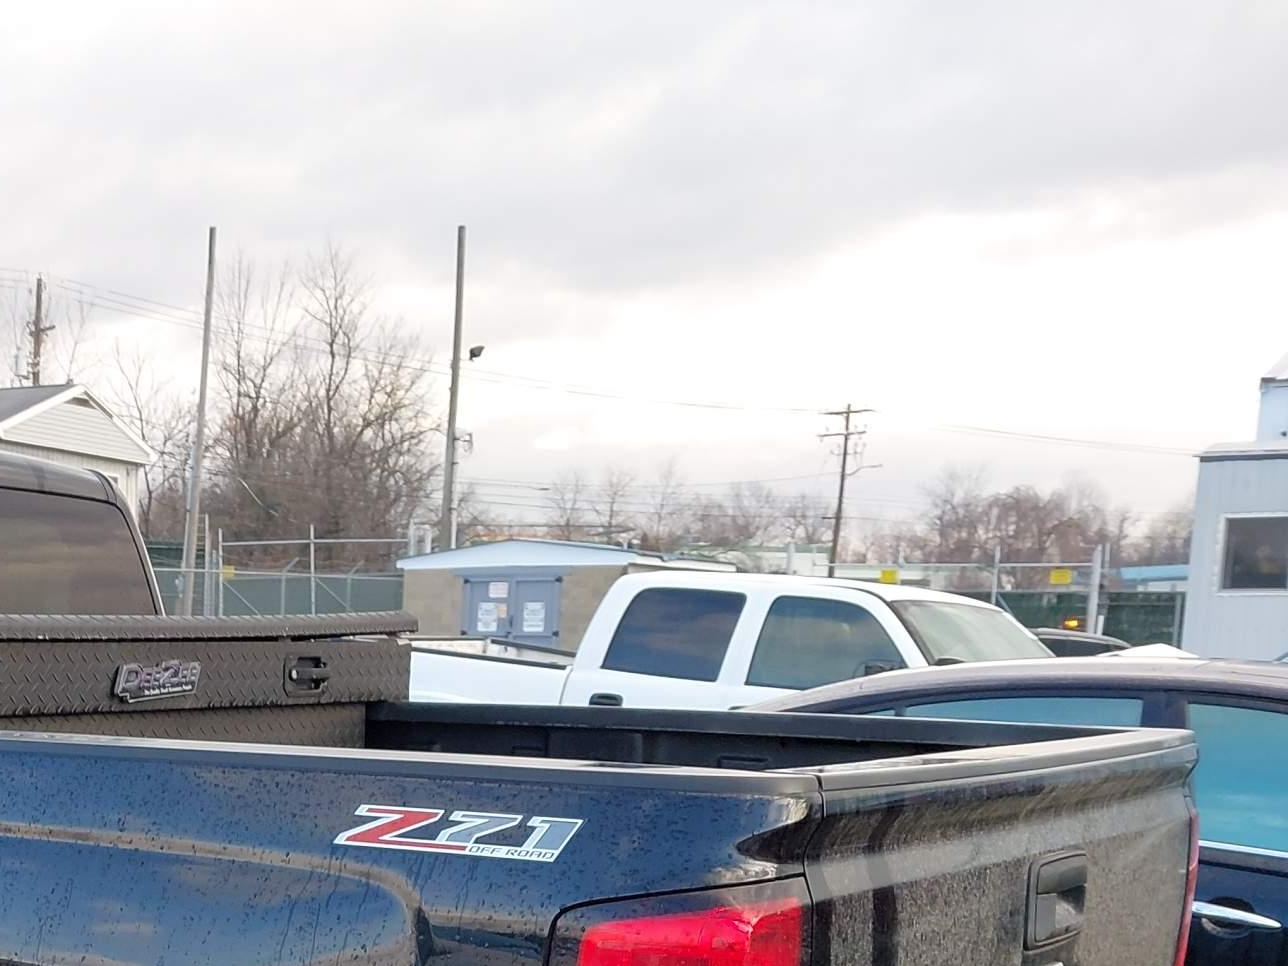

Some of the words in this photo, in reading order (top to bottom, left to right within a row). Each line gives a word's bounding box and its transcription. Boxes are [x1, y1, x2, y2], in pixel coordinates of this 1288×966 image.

[332, 803, 585, 857] Z71
[468, 845, 503, 856] OFF
[504, 848, 556, 860] ROAD
